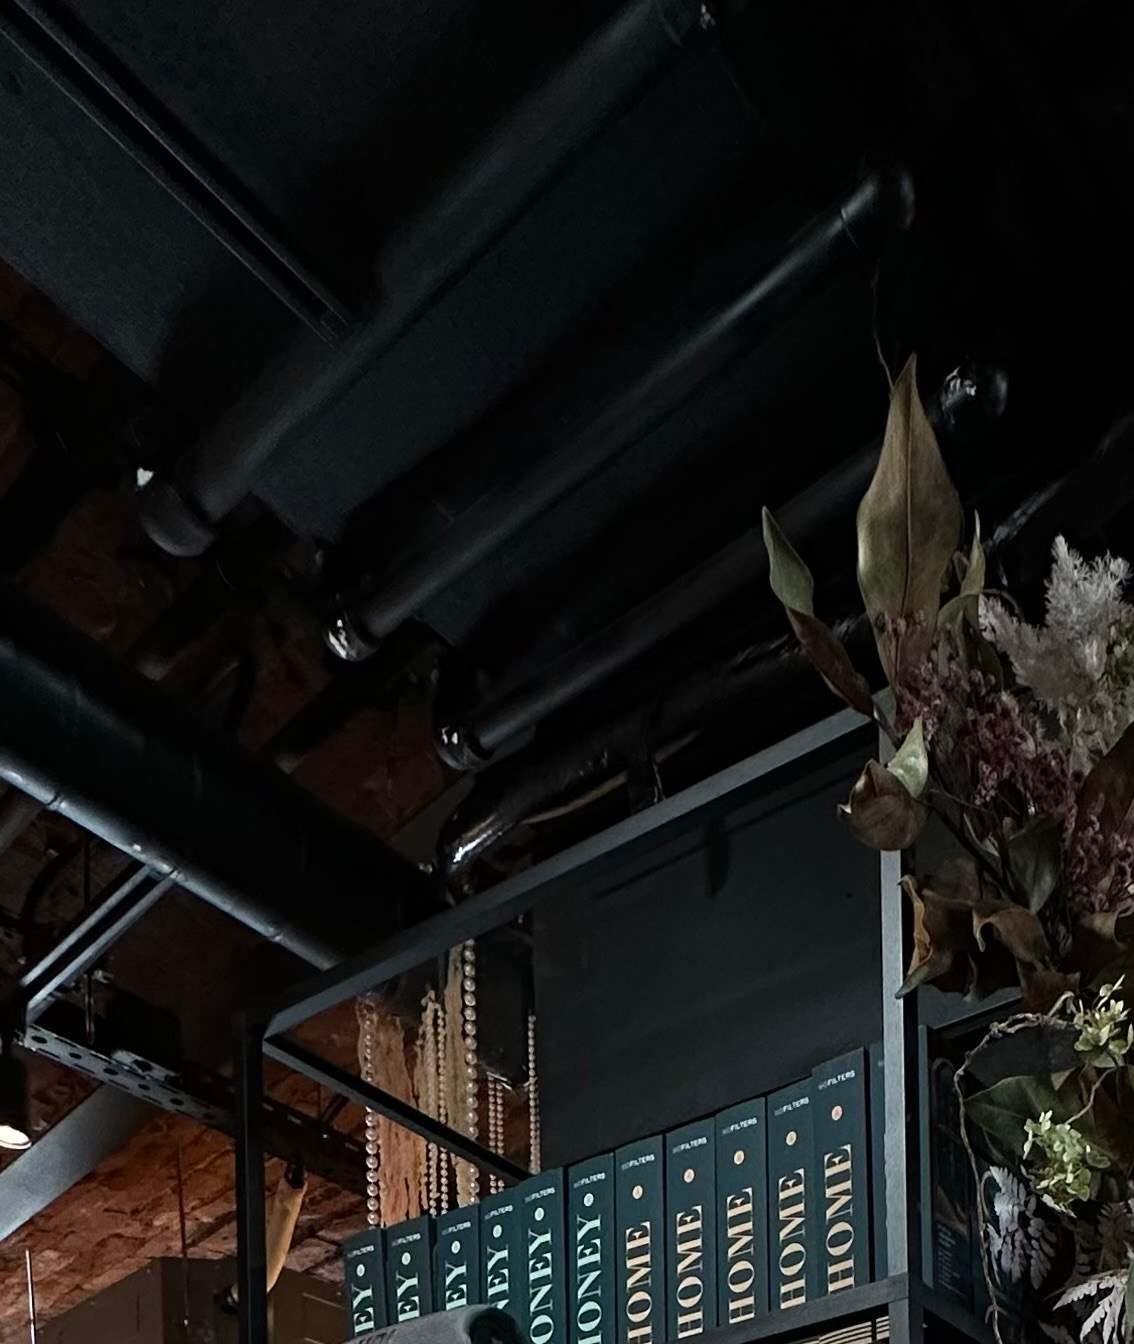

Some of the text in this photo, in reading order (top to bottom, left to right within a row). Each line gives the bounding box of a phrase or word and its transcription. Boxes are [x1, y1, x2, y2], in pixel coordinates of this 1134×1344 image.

[676, 1204, 704, 1339] HOME
[726, 1186, 755, 1325] HOME
[778, 1167, 807, 1310] HOME
[823, 1143, 855, 1295] HOME
